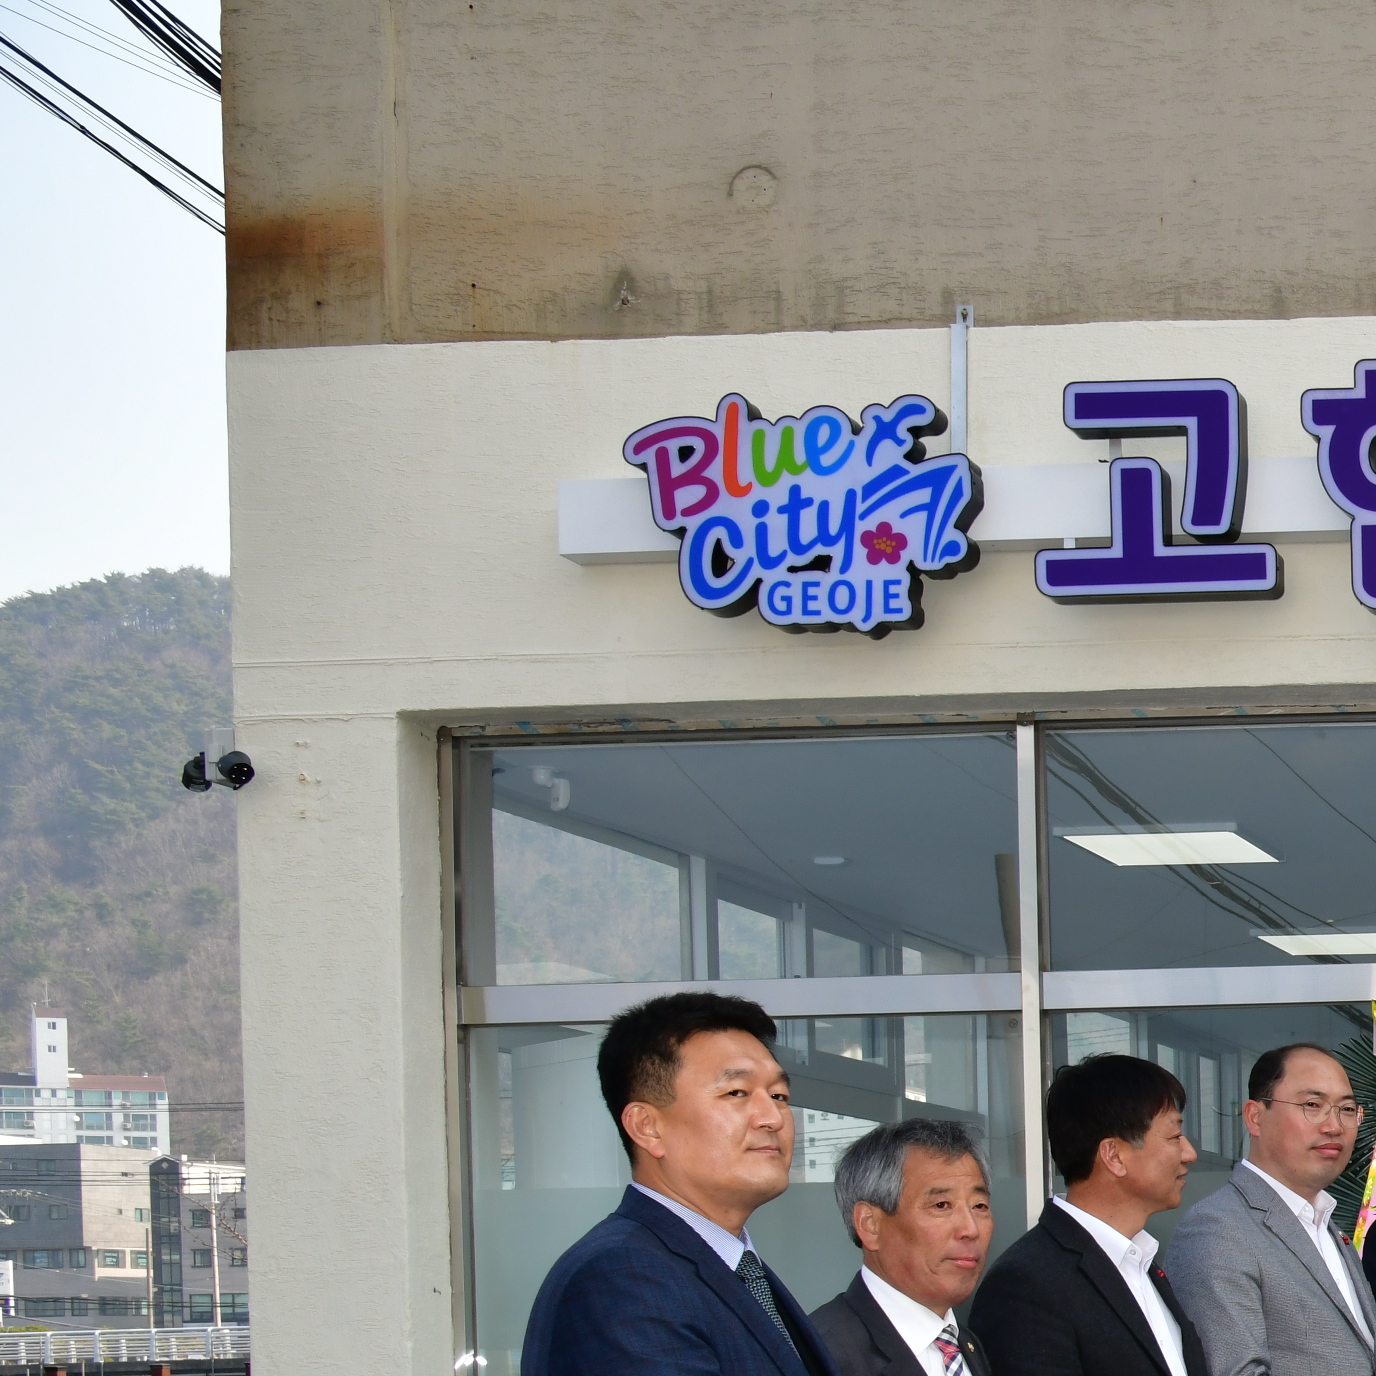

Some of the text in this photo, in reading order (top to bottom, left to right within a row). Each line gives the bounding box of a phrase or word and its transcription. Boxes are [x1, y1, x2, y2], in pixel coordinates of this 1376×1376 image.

[632, 401, 855, 521] Blue
[688, 484, 858, 601] City
[766, 578, 904, 624] GEOJE
